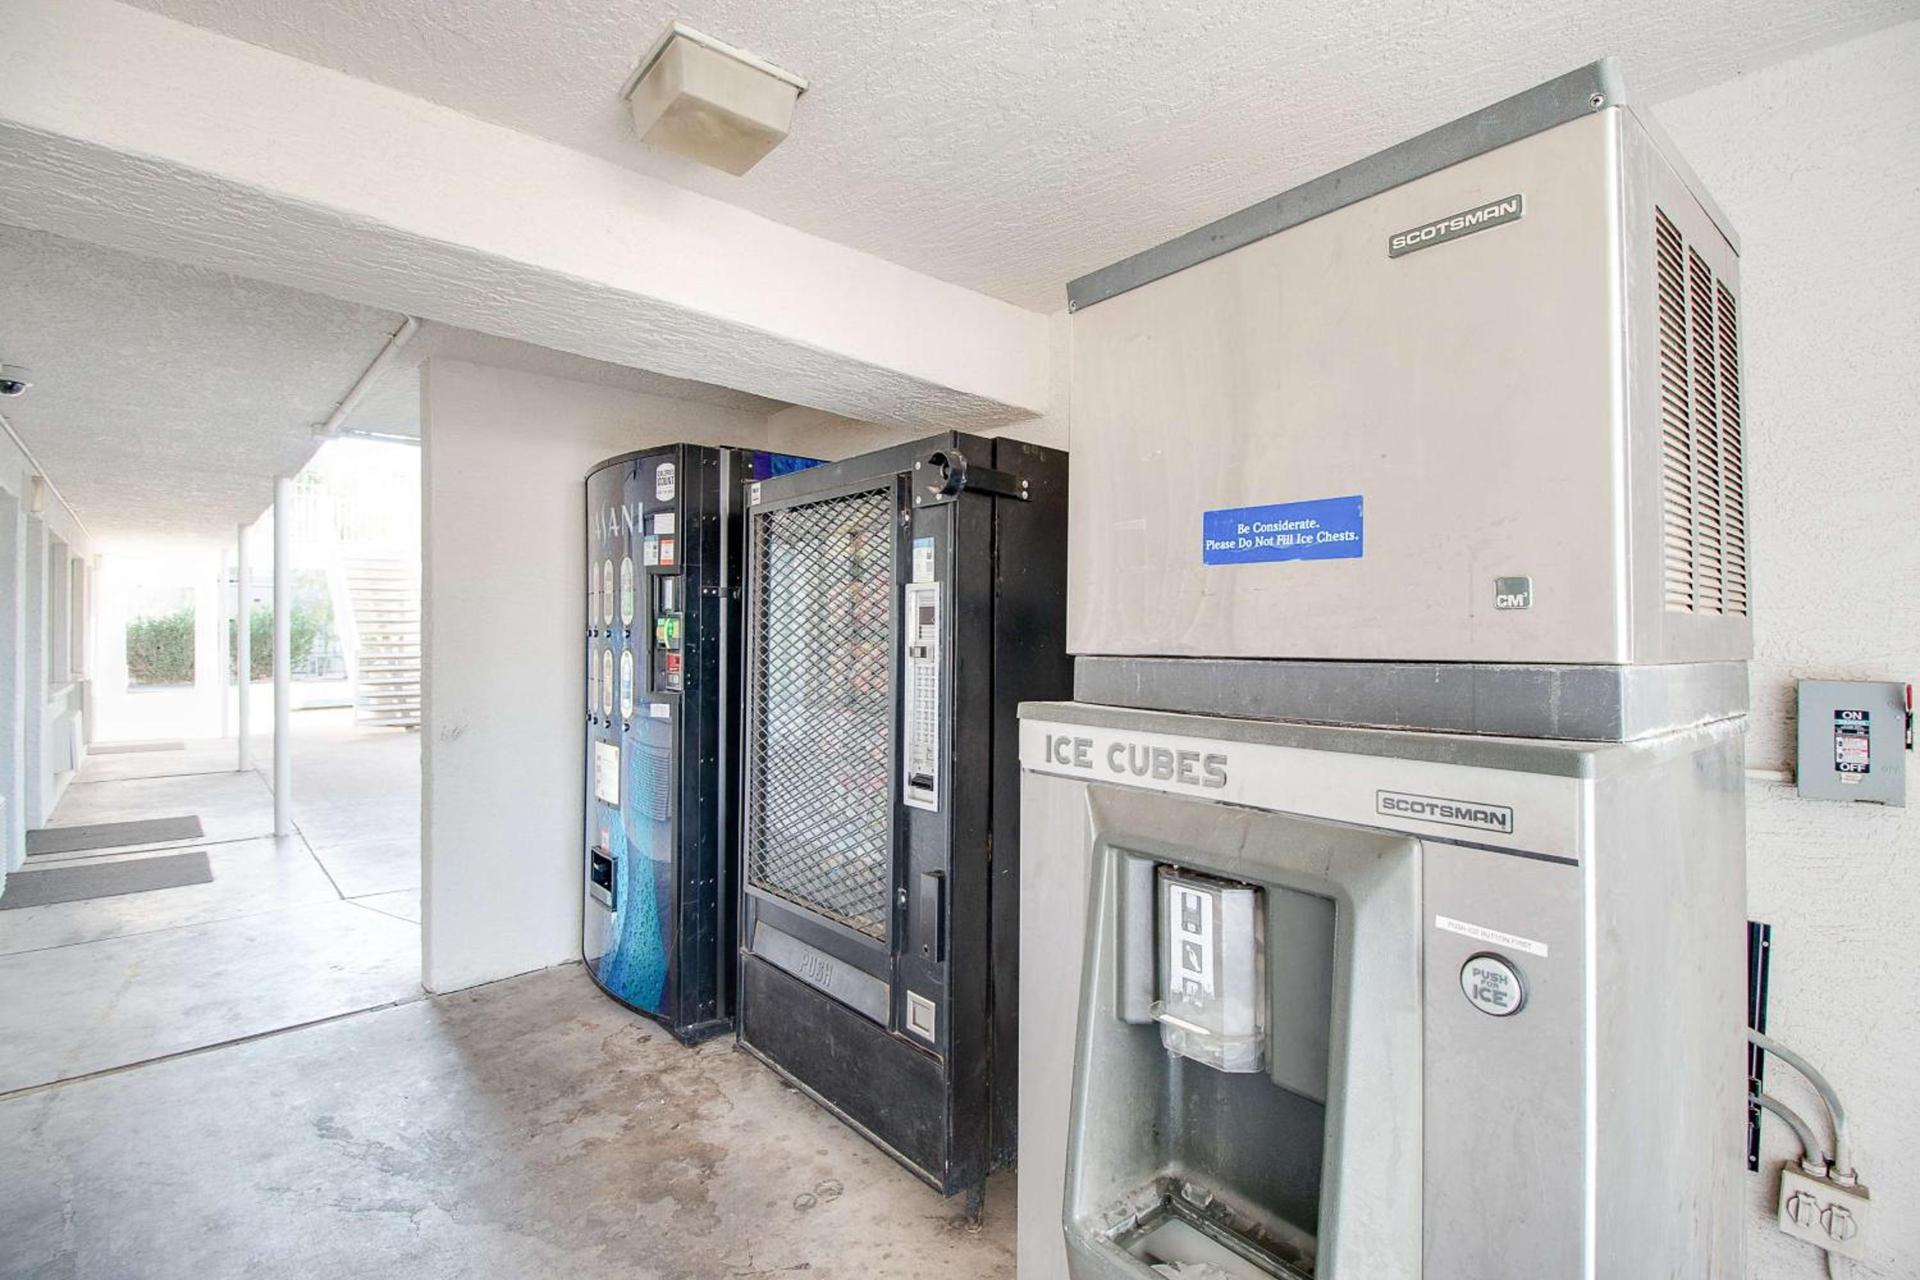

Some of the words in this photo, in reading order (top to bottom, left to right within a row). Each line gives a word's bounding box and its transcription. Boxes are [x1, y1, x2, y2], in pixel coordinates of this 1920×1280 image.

[1392, 199, 1517, 249] SCOTSMAN
[1237, 523, 1250, 534] Be
[1253, 518, 1320, 533] Considerate.
[1206, 540, 1236, 550] Please
[1238, 537, 1253, 549] Do
[1255, 535, 1274, 547] Not
[1276, 533, 1293, 546] Fill
[1296, 532, 1313, 545] Ice
[1316, 530, 1360, 542] Chests.
[1842, 711, 1863, 720] ON
[1045, 734, 1093, 769] ICE
[1107, 742, 1228, 789] CUBES
[1840, 763, 1866, 772] OFF
[1382, 797, 1507, 826] SCOTSMAN
[800, 953, 833, 986] PUSH
[1472, 967, 1508, 985] PUSH
[1480, 980, 1500, 989] FOR
[1473, 984, 1507, 1007] ICE
